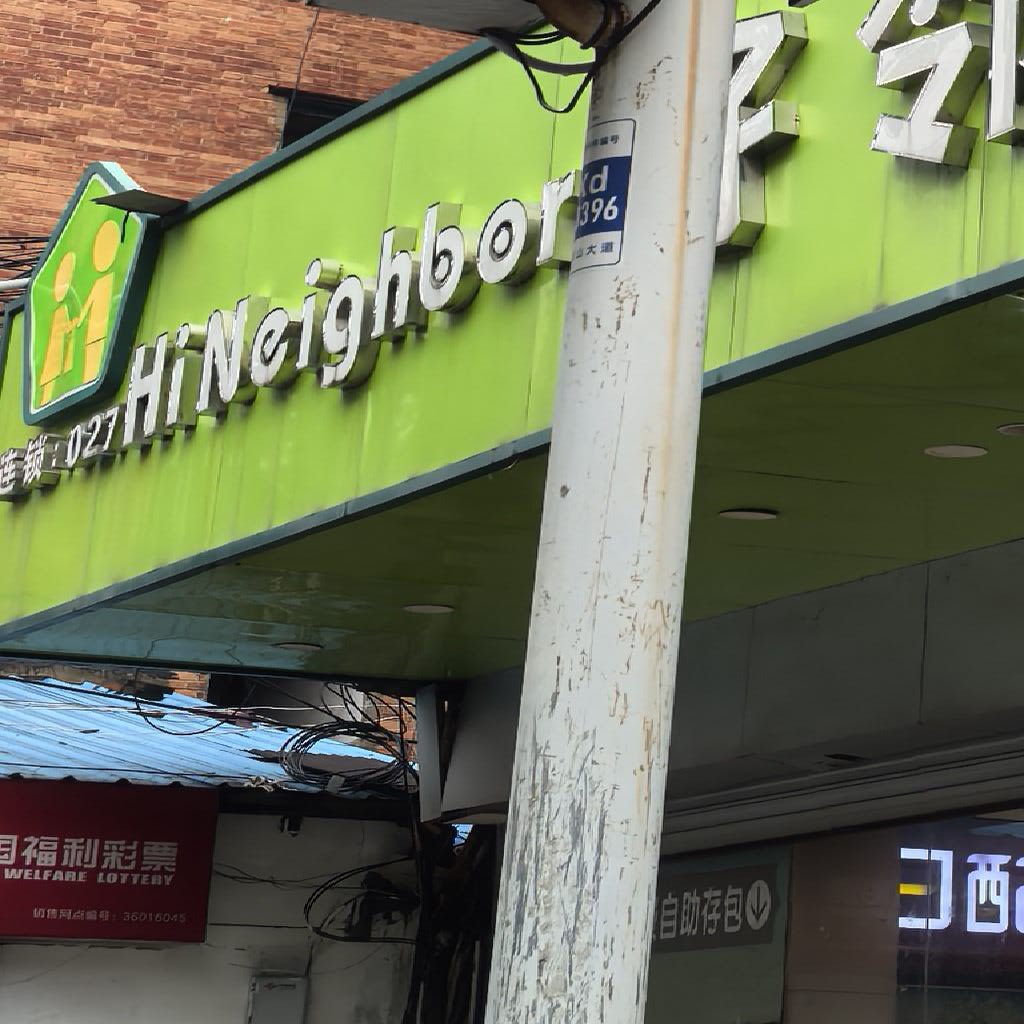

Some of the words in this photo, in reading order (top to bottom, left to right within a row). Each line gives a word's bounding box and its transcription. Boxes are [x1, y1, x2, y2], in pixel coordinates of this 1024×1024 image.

[576, 195, 619, 228] 396
[123, 168, 583, 448] HiNeighbor
[4, 868, 88, 882] WELFARE
[97, 872, 175, 886] LOTTERY
